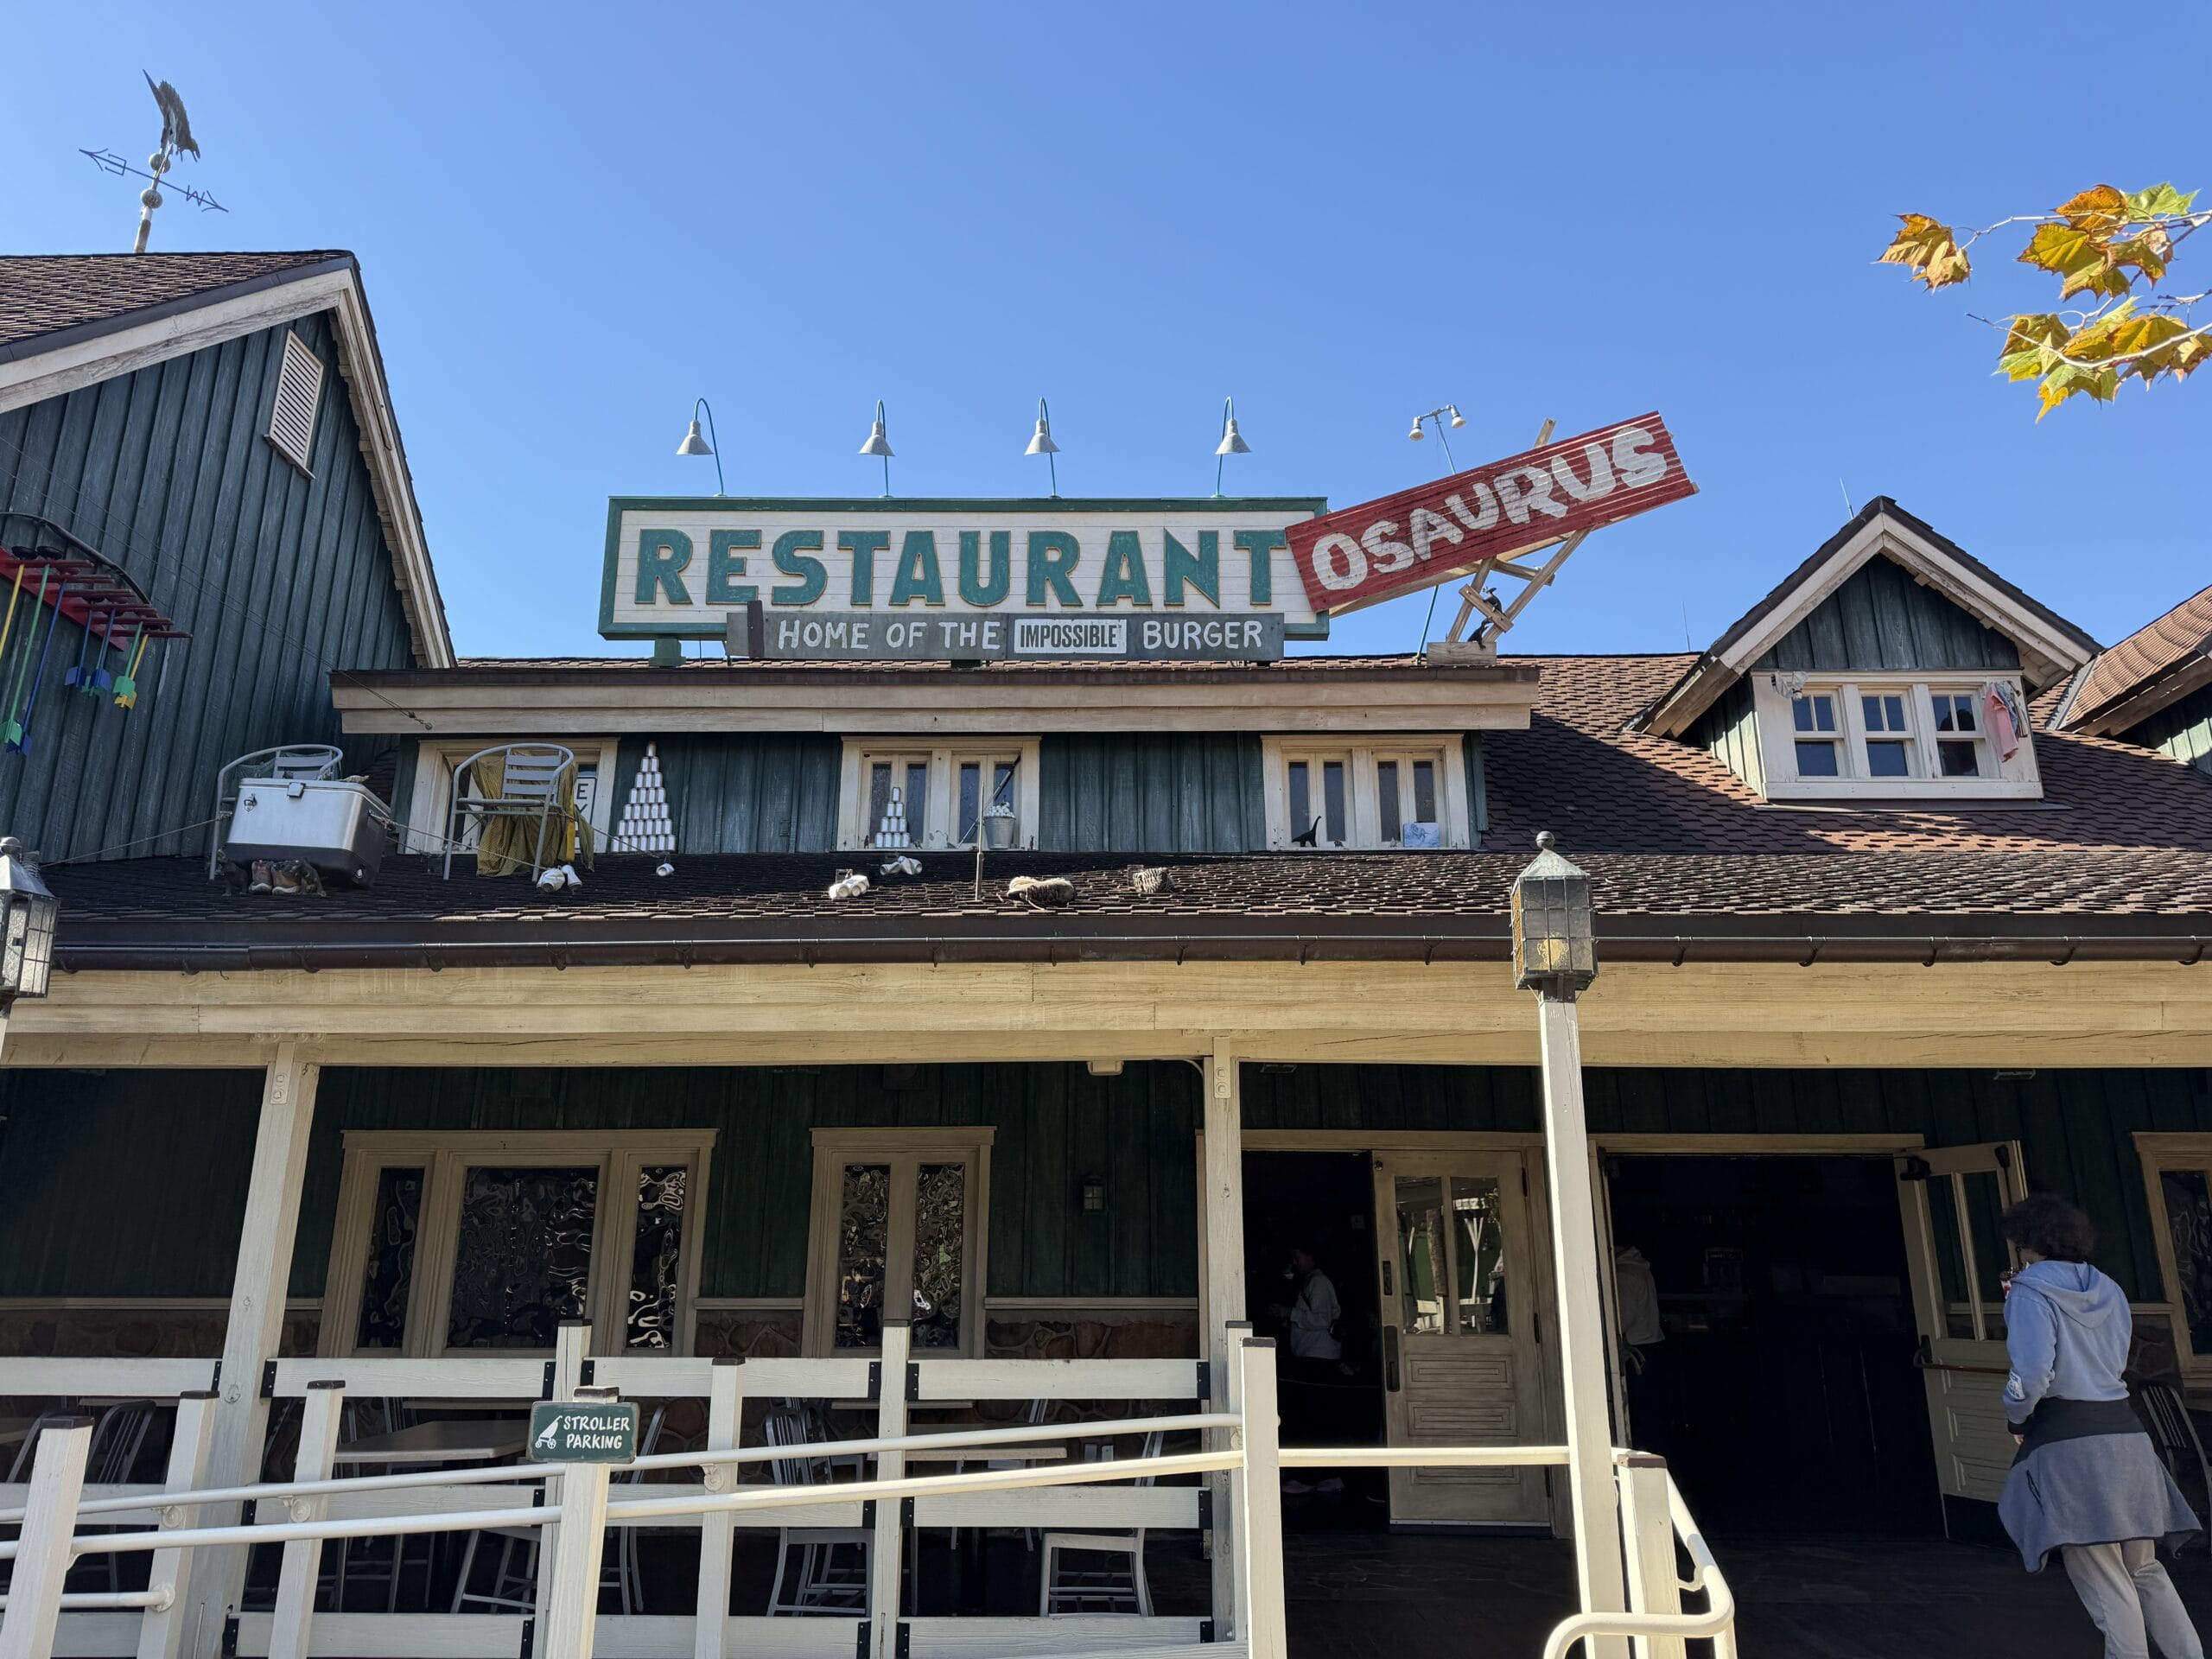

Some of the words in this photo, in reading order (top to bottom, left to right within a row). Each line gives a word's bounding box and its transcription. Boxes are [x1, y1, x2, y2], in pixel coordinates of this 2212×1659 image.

[1312, 426, 1668, 590] OSAURUS
[634, 527, 1287, 609] RESTAURANT
[778, 620, 869, 650] HOME
[886, 621, 927, 648] OF
[938, 620, 1001, 650] THE
[1020, 624, 1118, 648] IMPOSSIBLE
[1143, 620, 1263, 650] BURGER
[563, 1415, 630, 1431] STROLLER
[566, 1433, 622, 1449] PARKING
